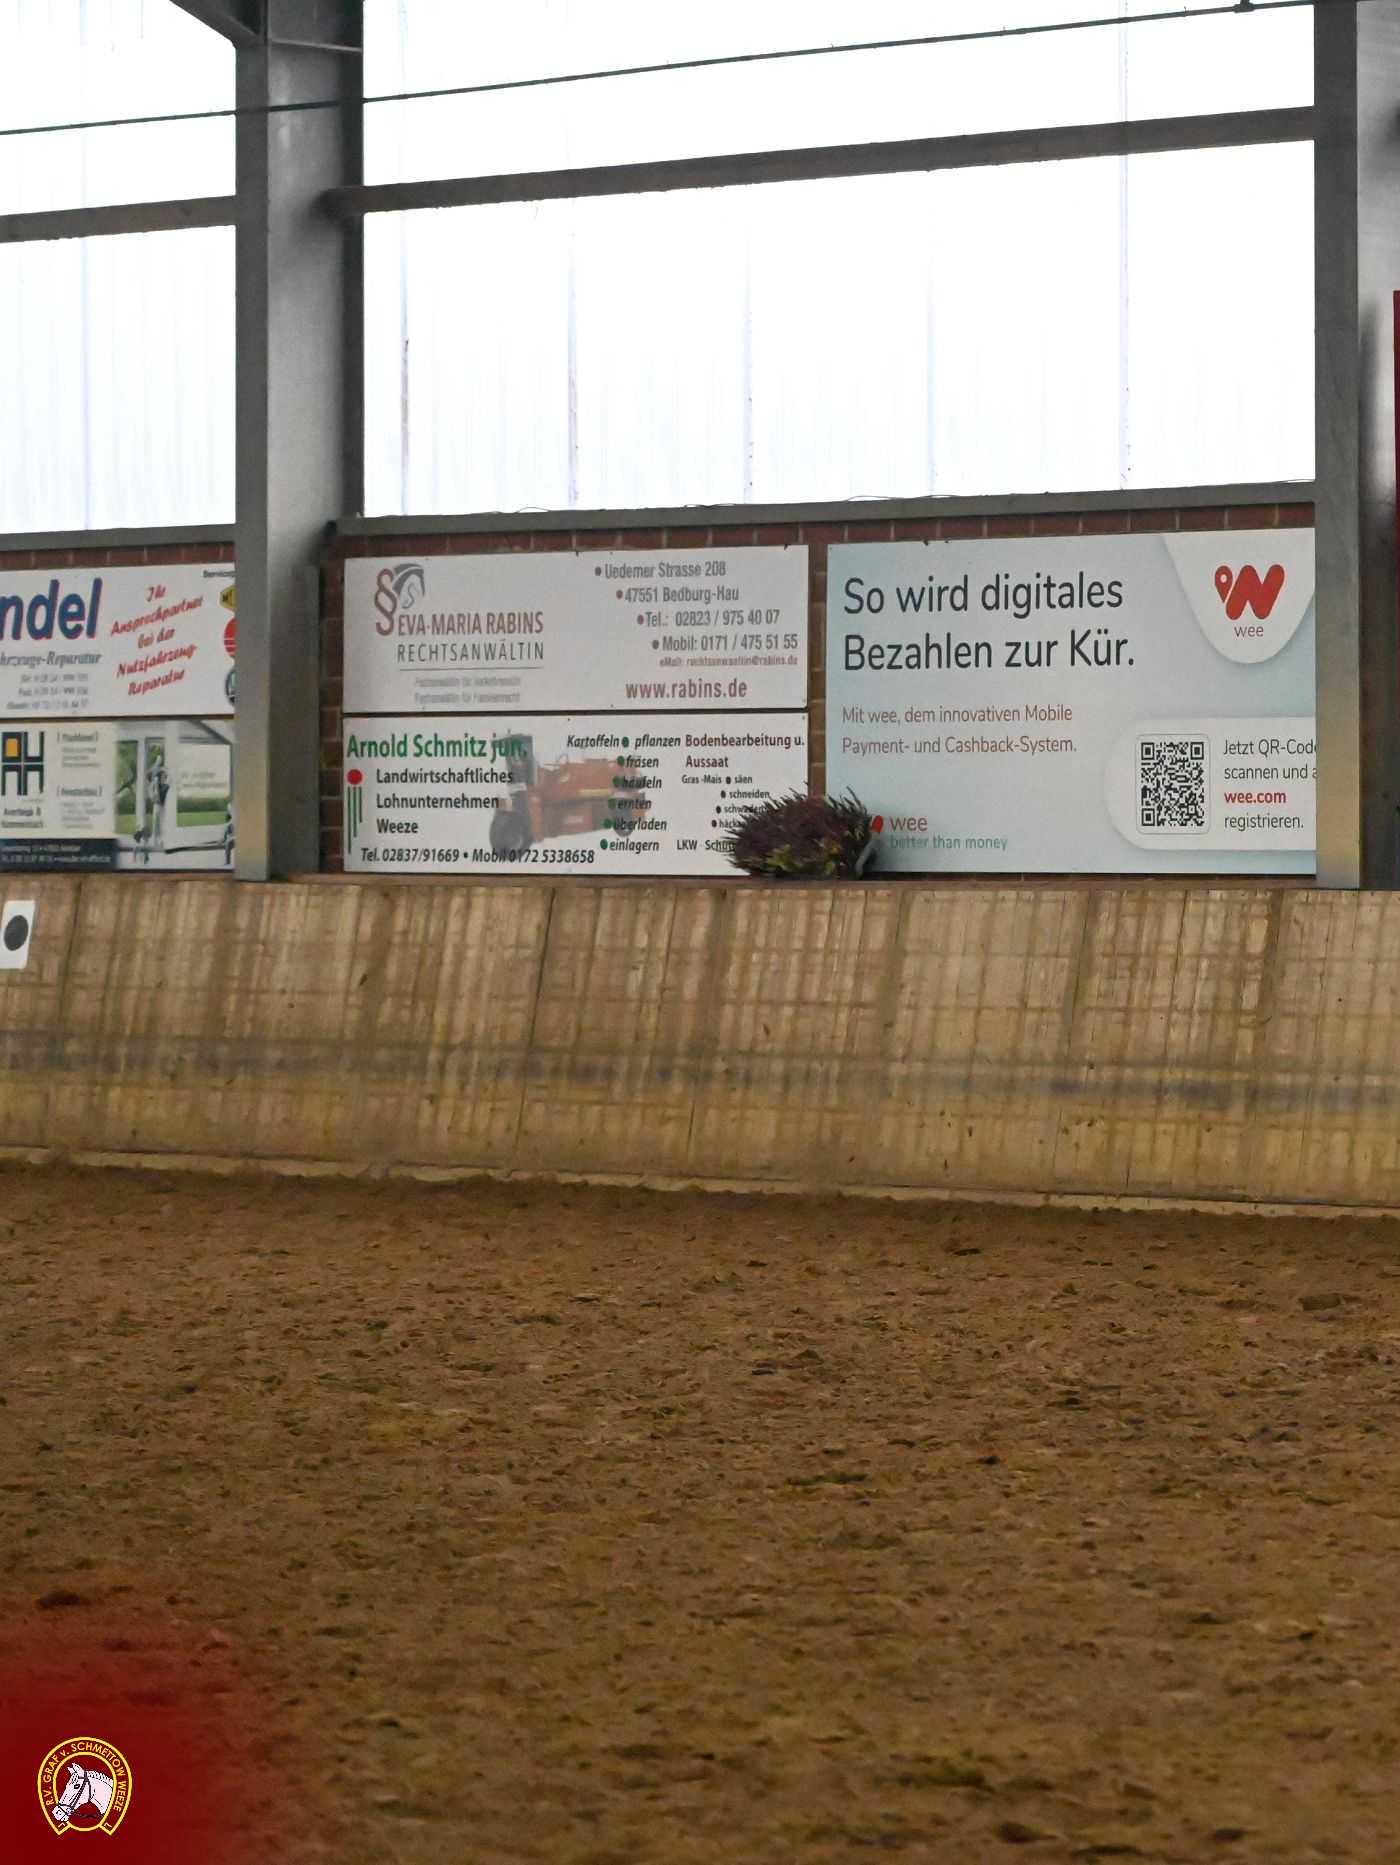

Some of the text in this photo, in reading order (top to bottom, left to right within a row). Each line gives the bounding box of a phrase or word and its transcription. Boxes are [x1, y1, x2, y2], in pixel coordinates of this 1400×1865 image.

[605, 561, 727, 579] Uedemer Strasse 208
[625, 585, 739, 604] 47551 Bedburg-Hau
[844, 571, 1123, 619] So wird digitales
[486, 611, 544, 635] RABINS
[675, 611, 711, 626] 02823
[723, 610, 744, 625] 975
[748, 609, 762, 625] 40
[765, 609, 780, 624] 07
[1234, 624, 1264, 638] wee
[397, 638, 544, 662] RECHTSANWÄLTIN
[663, 635, 697, 651] Mobil:
[701, 635, 728, 650] 0171
[741, 634, 762, 649] 475
[766, 634, 779, 649] 51
[783, 633, 798, 649] 55
[845, 628, 1134, 670] Bezahlen zur Kür.
[128, 669, 185, 695] Reparatur
[626, 678, 748, 698] www.rabins.de
[842, 704, 1073, 725] Mit wee, dem innovativen Mobile
[347, 732, 527, 764] Arnold Schmitz jun.
[567, 733, 681, 750] Kartoffeln pflanzen
[685, 733, 805, 750] Bodenbearbeitung u.
[842, 734, 1077, 757] Payment- und Cashback-System.
[1224, 739, 1254, 755] Jetzt
[686, 755, 729, 768] Aussaat
[376, 768, 513, 784] Landwirtschaftliches
[682, 774, 699, 784] Gras
[735, 774, 753, 784] säen
[1224, 767, 1279, 780] scannen
[1283, 763, 1308, 779] und
[376, 792, 499, 809] Lohnunternehmen
[729, 789, 770, 799] schneiden
[1224, 791, 1287, 804] wee.com
[377, 818, 419, 834] Weeze
[889, 816, 928, 832] wee
[1224, 812, 1304, 832] registrieren.
[609, 838, 660, 855] einlagern
[676, 840, 698, 850] LKW
[890, 834, 1008, 851] better than money
[361, 848, 379, 862] Tel.
[383, 848, 460, 863] 02837/91669
[509, 849, 539, 863] 0172
[541, 849, 595, 864] 5338658
